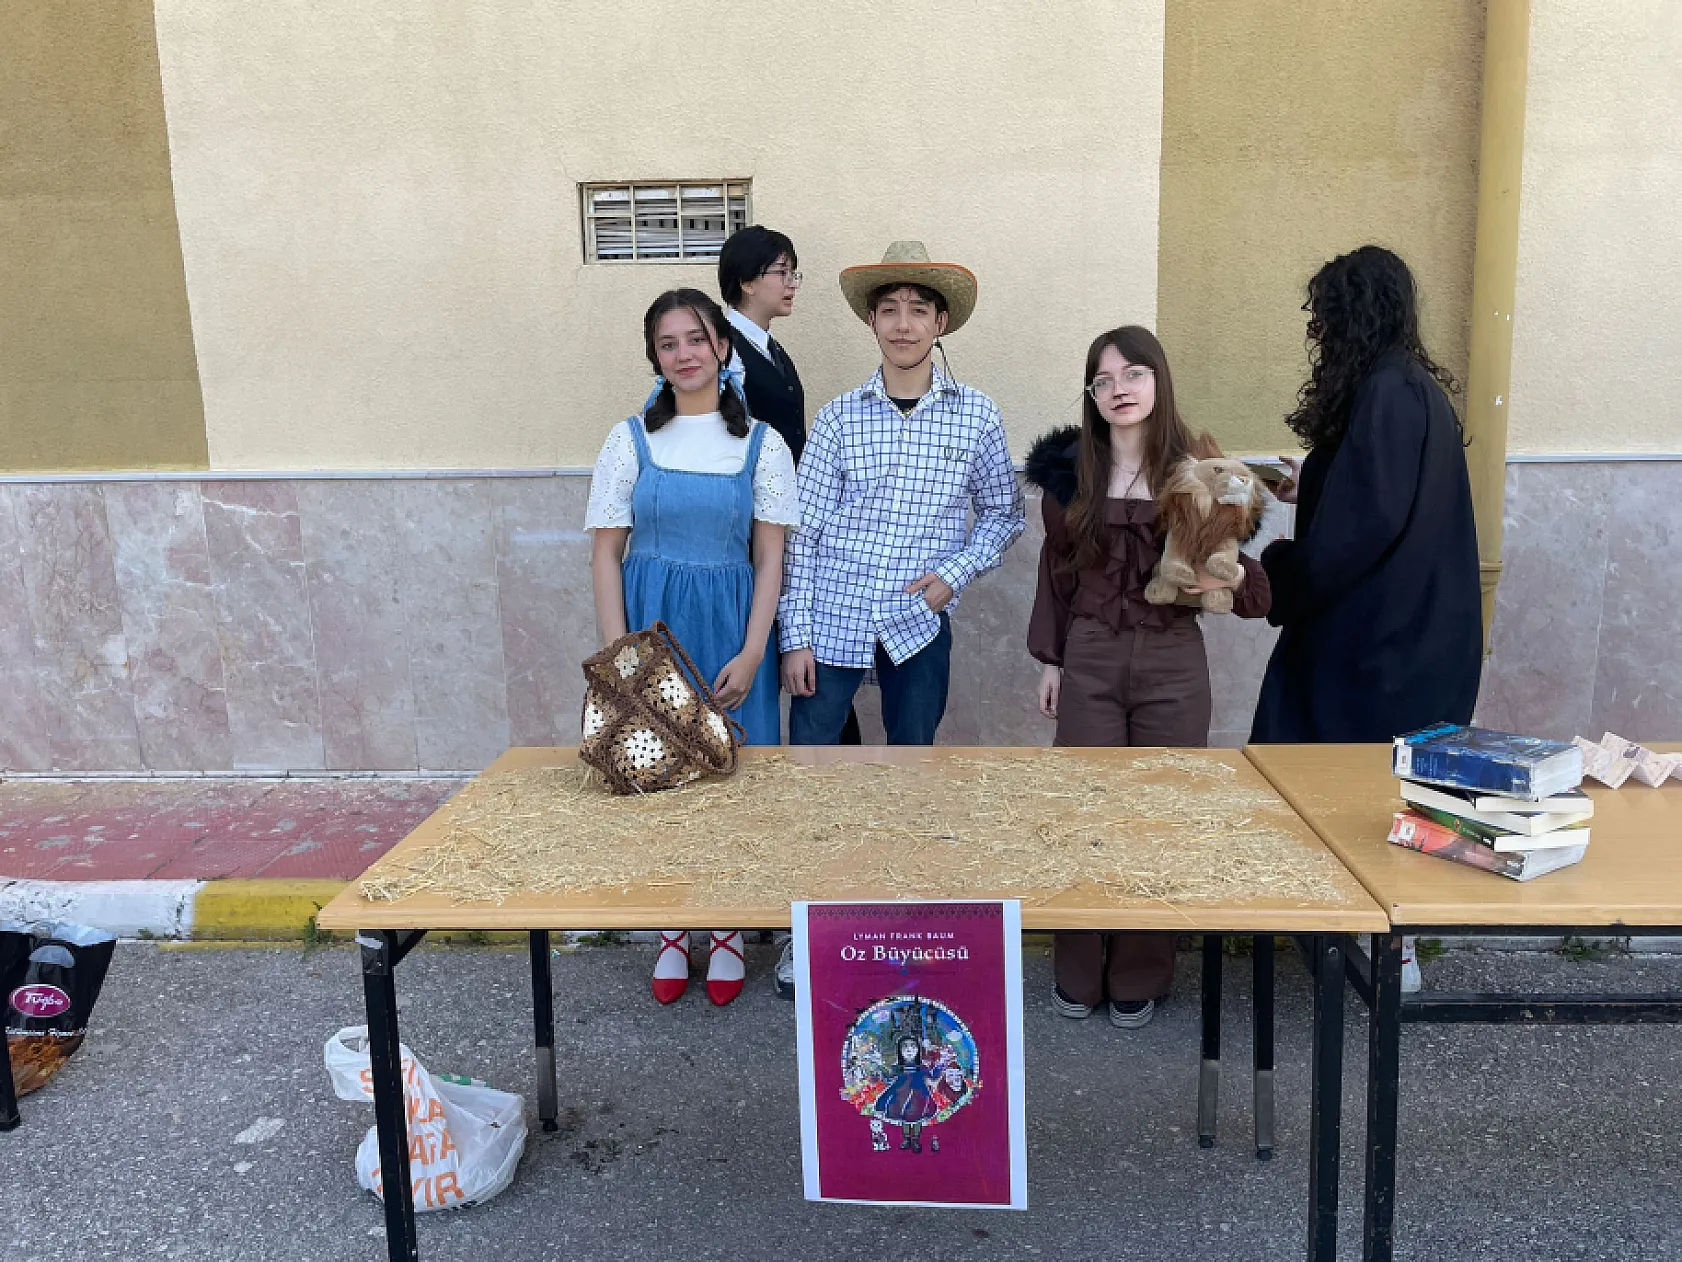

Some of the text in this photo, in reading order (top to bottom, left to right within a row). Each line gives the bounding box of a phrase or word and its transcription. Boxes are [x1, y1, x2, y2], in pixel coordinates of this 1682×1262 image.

[853, 932, 886, 940] LYMAN
[890, 932, 923, 940] FRANK
[840, 945, 970, 966] Oz Büyücüsü
